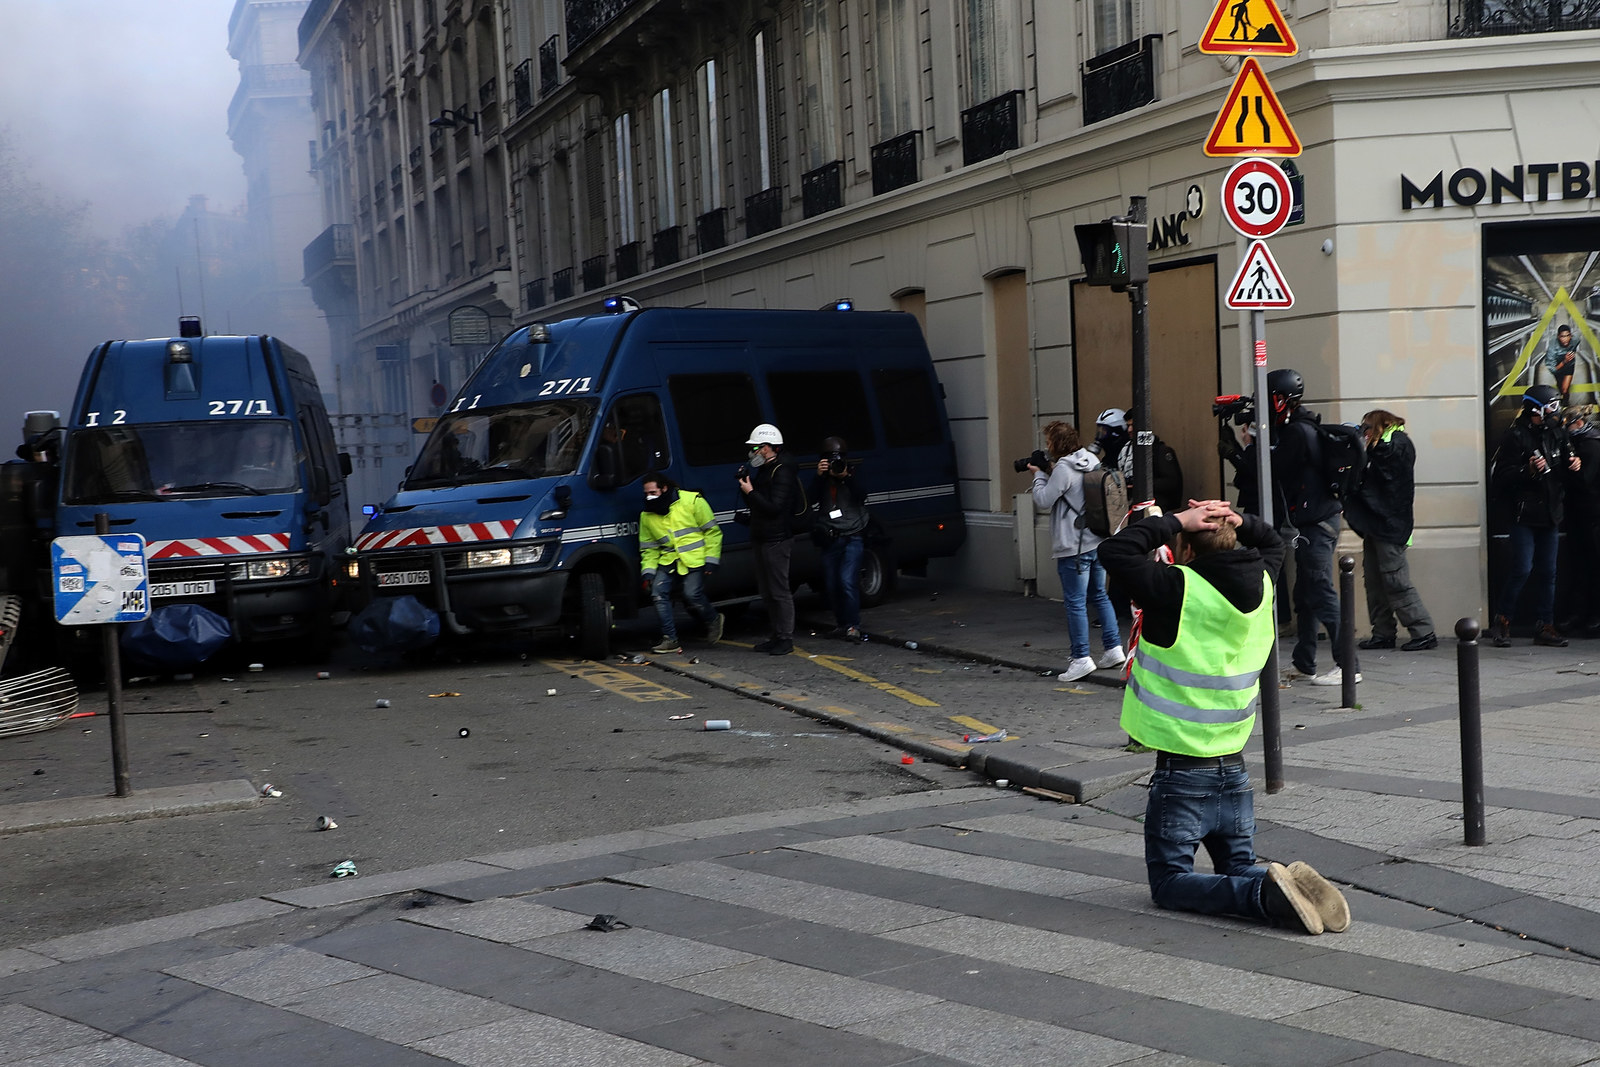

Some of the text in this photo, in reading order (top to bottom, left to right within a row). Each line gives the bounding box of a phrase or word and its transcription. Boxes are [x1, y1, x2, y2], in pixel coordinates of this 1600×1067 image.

[1401, 160, 1600, 210] MONTB
[1237, 181, 1278, 215] 30
[538, 377, 592, 396] 27/1
[208, 400, 272, 416] 27/1
[467, 395, 482, 410] 1
[86, 410, 127, 427] I 2
[384, 573, 405, 585] 2051
[151, 581, 210, 596] 2051 0767
